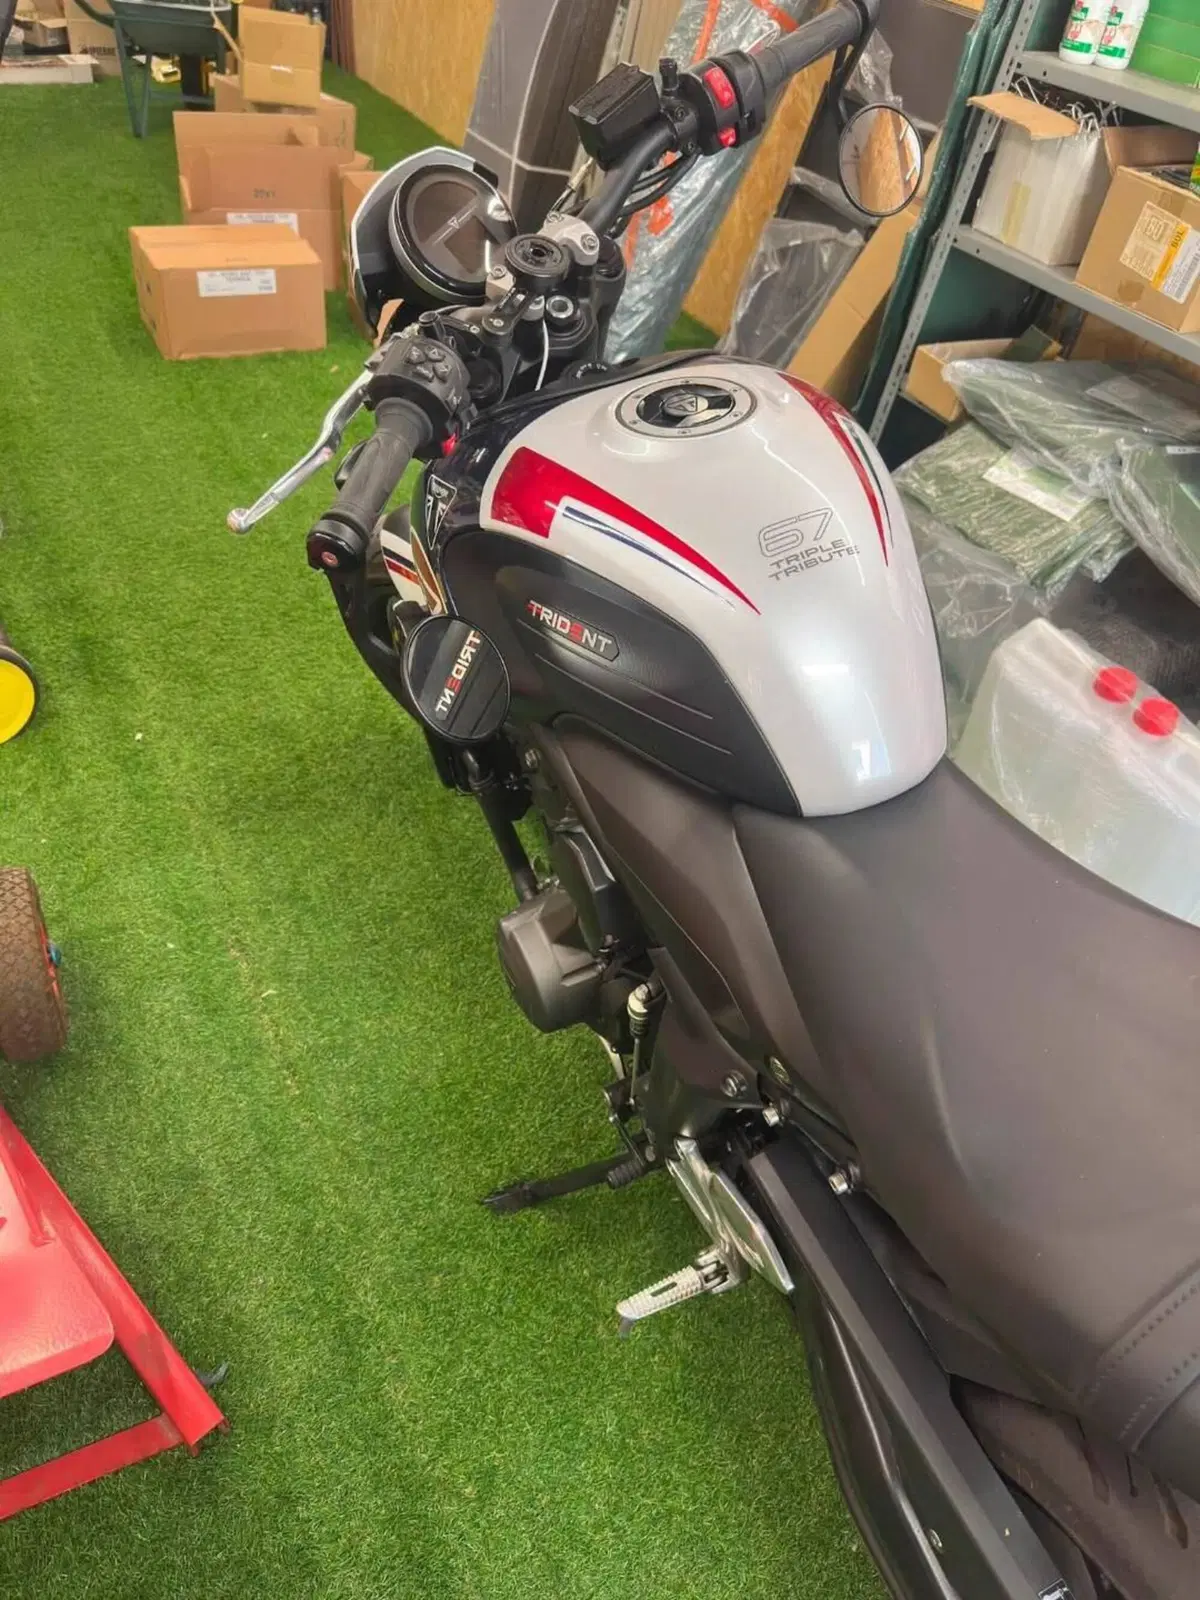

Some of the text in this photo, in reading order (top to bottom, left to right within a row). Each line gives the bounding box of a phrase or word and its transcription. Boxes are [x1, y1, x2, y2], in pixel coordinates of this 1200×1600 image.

[758, 507, 834, 557] 67
[768, 545, 860, 581] TRIBUTE
[769, 538, 846, 570] TRIPLE
[527, 600, 612, 653] TRIDENT
